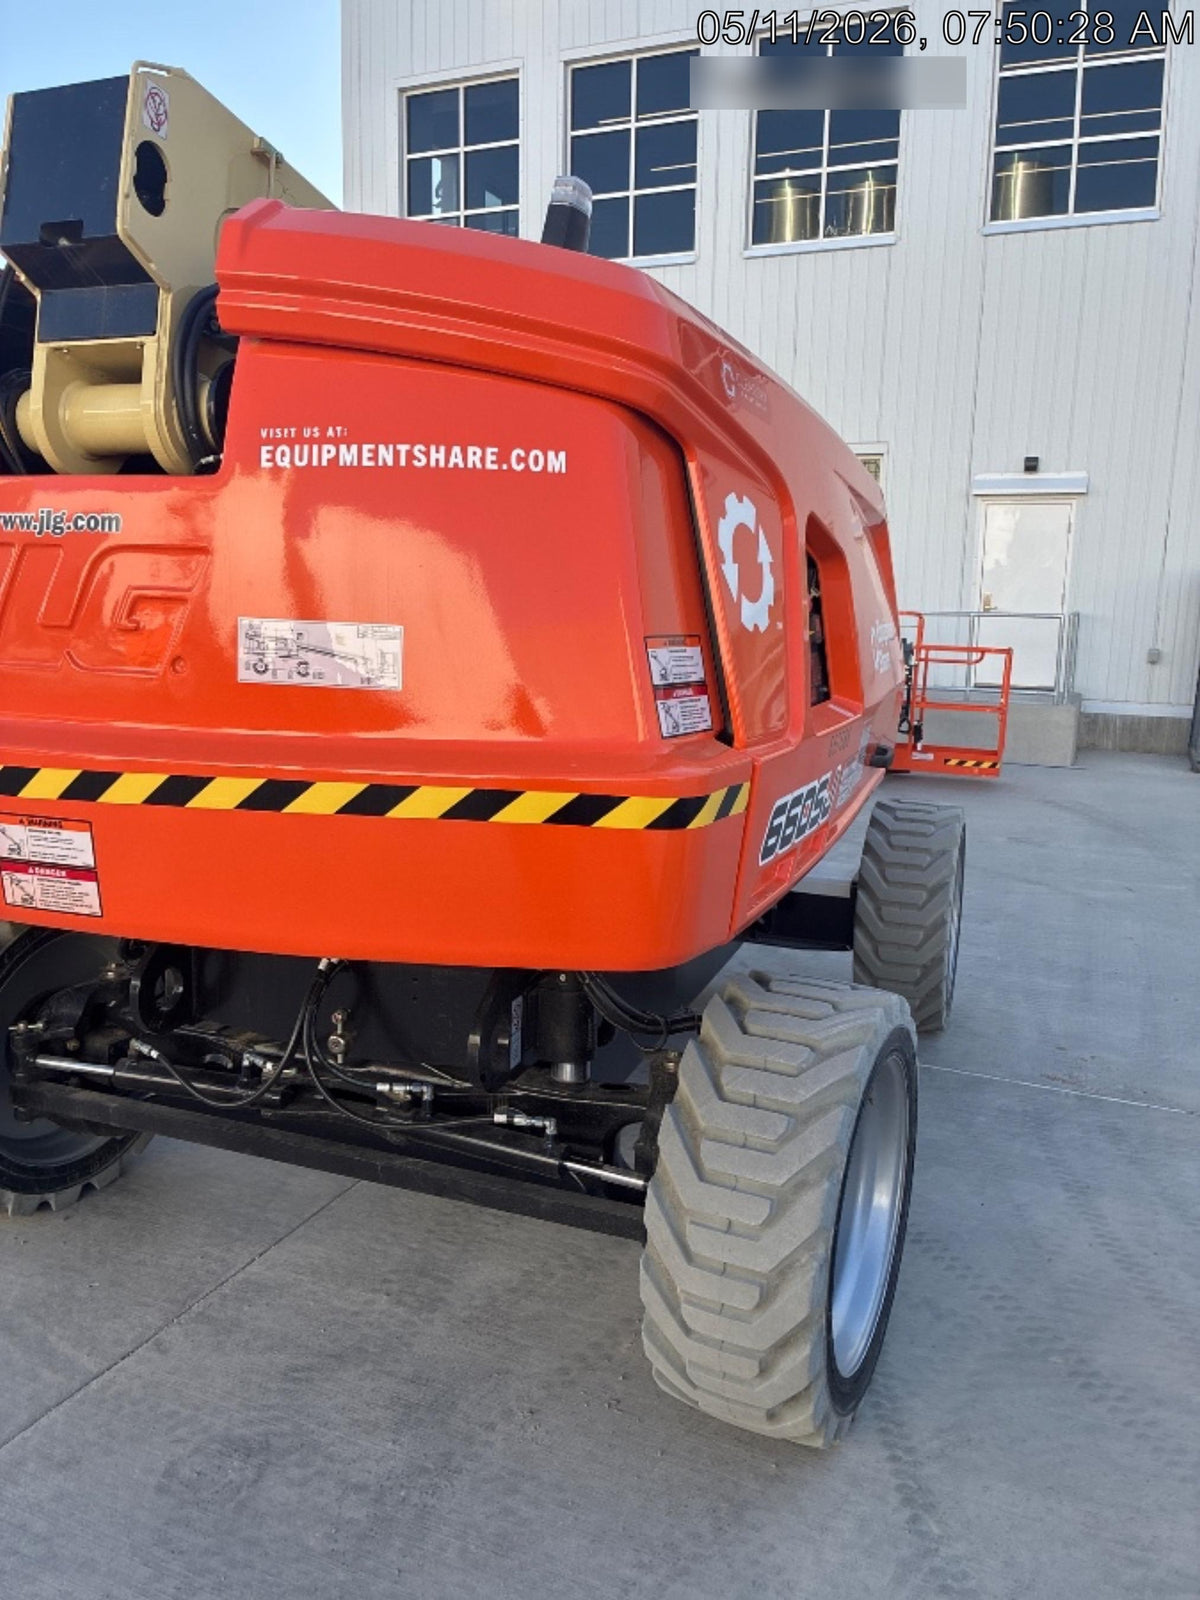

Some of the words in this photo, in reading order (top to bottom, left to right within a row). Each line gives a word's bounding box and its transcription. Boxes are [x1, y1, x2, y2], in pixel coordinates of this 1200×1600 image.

[260, 427, 297, 438] VISIT
[303, 426, 320, 438] US
[326, 426, 348, 438] AT:
[260, 444, 567, 473] EQUIPMENTSHARE.COM
[0, 508, 121, 536] ww.jlg.com
